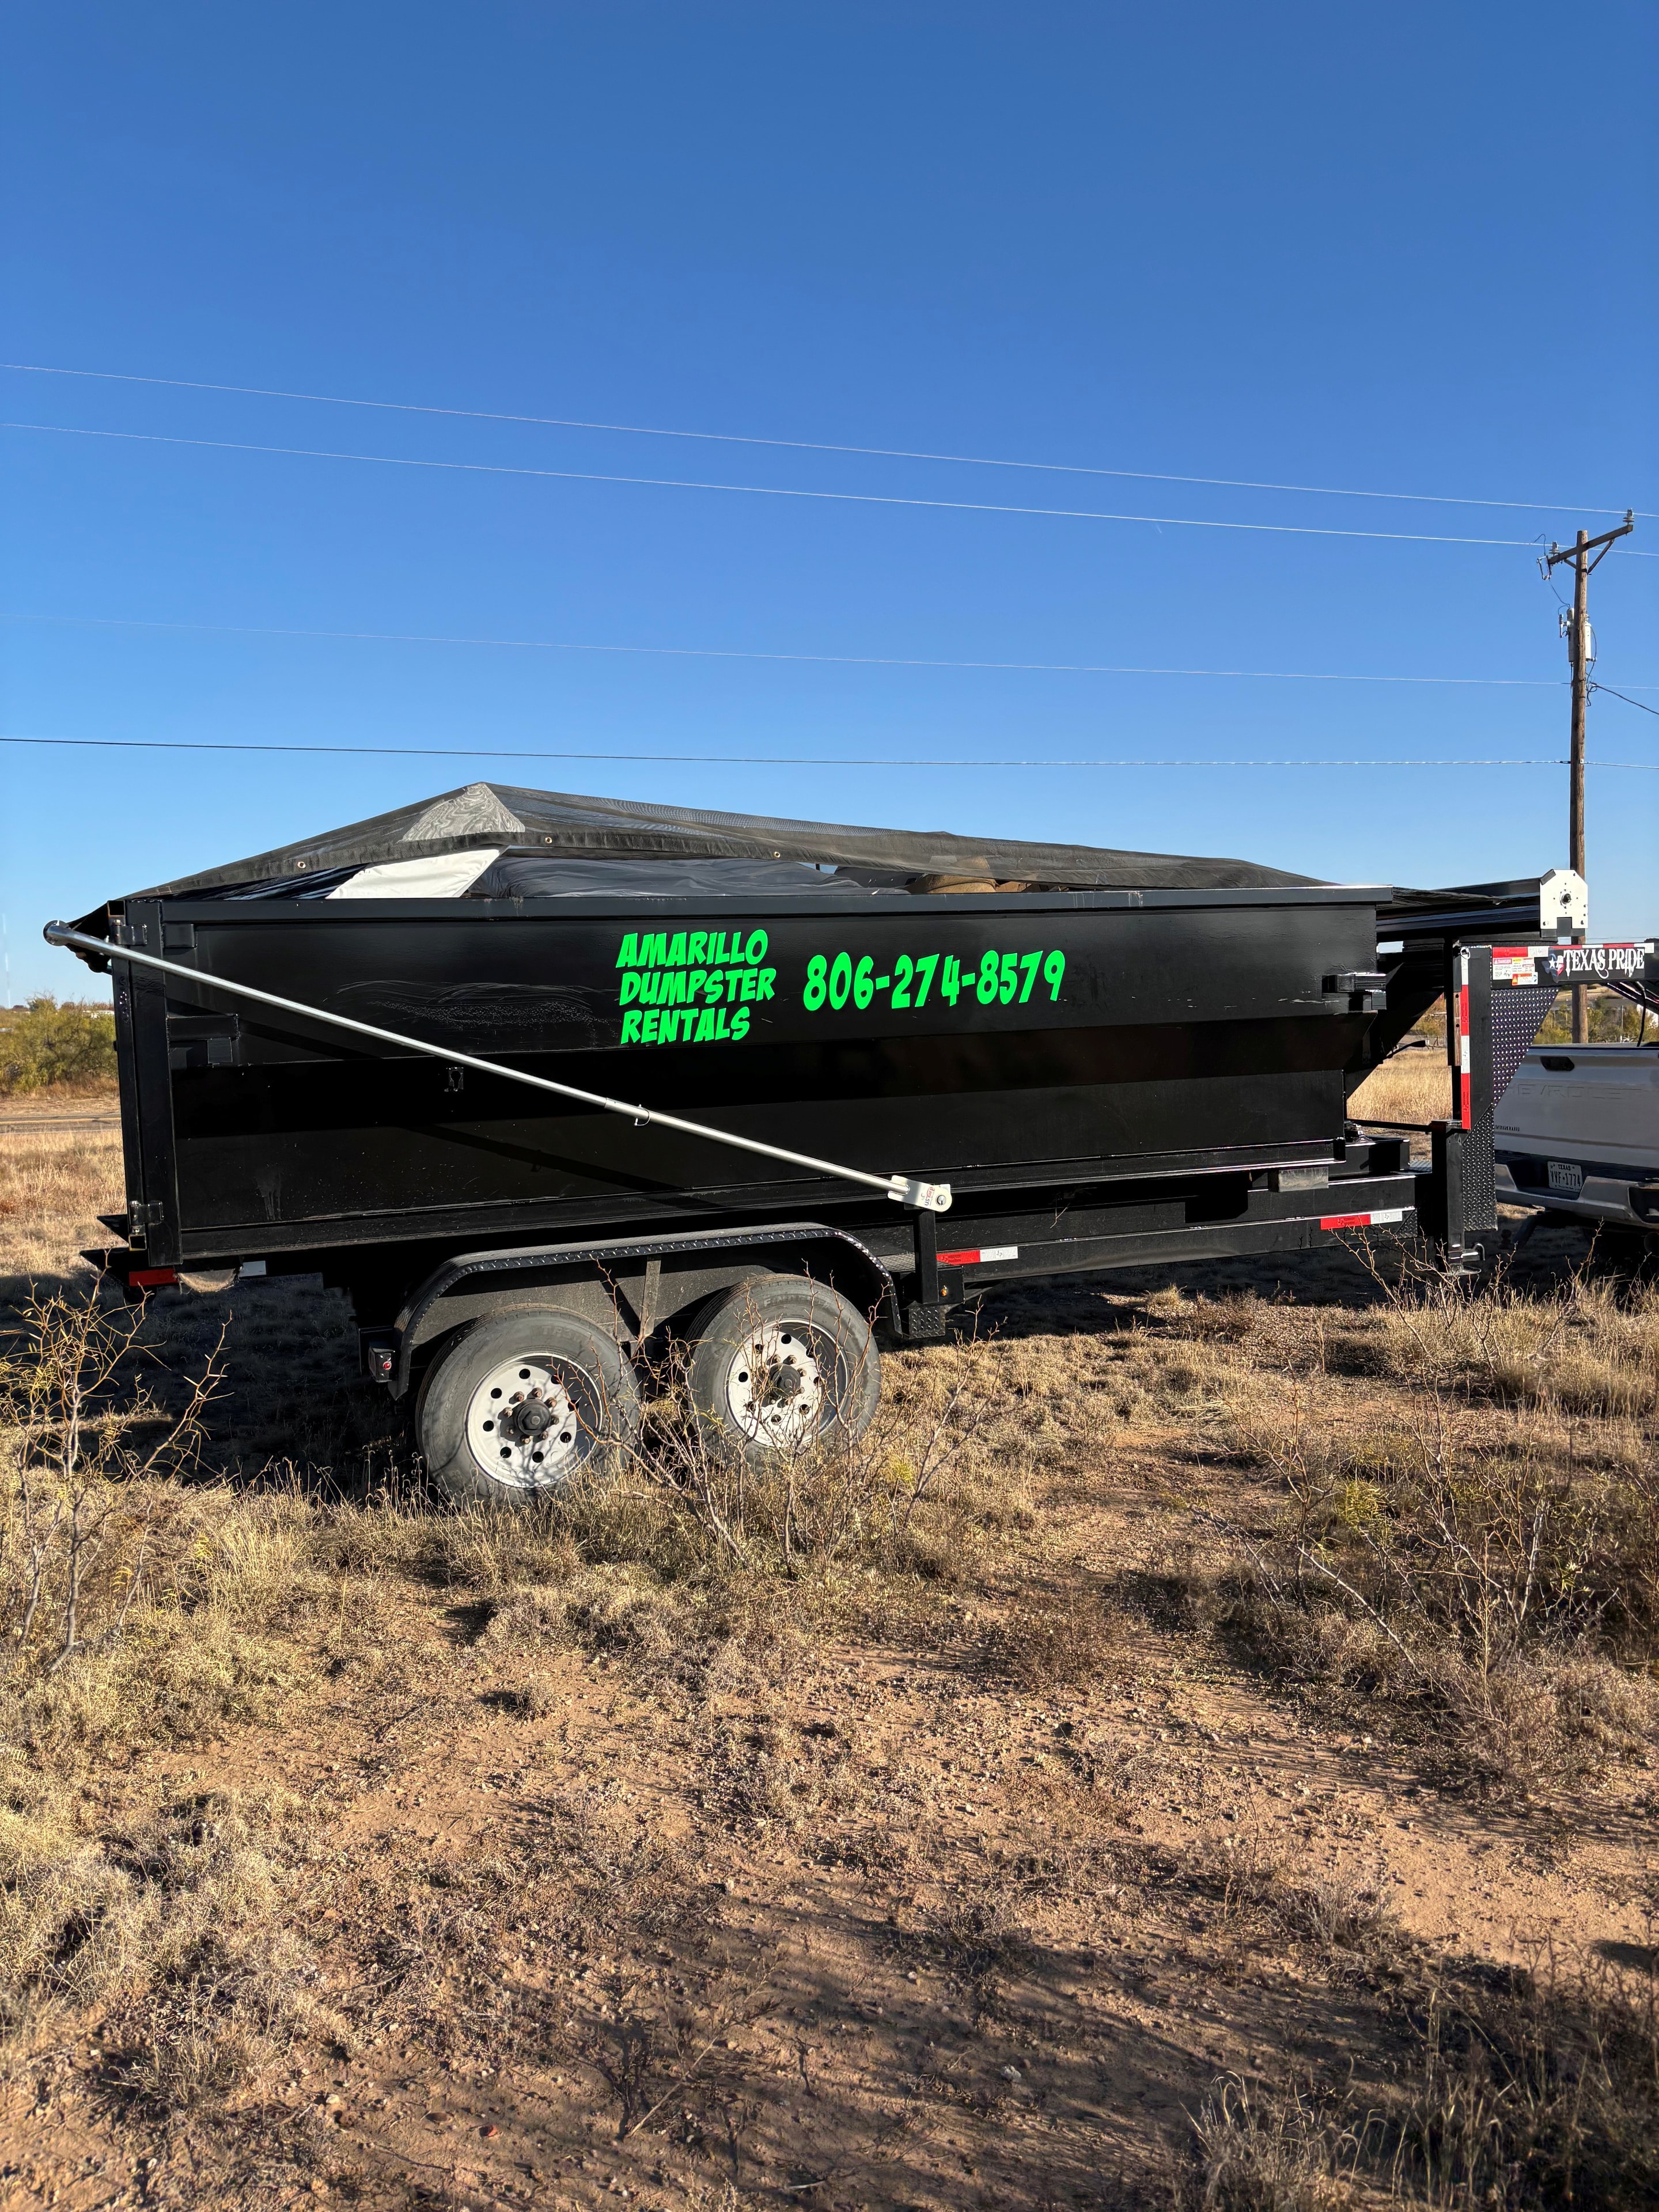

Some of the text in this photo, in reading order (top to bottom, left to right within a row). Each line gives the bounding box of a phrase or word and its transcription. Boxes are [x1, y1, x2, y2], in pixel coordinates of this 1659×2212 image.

[616, 930, 768, 968] AMARILLO
[1563, 949, 1609, 979] TEXAS
[1608, 948, 1645, 978] PRIDE
[620, 968, 776, 1006] DUMPSTER
[804, 950, 1065, 1010] 806-274-8579
[621, 1007, 749, 1044] RENTALS
